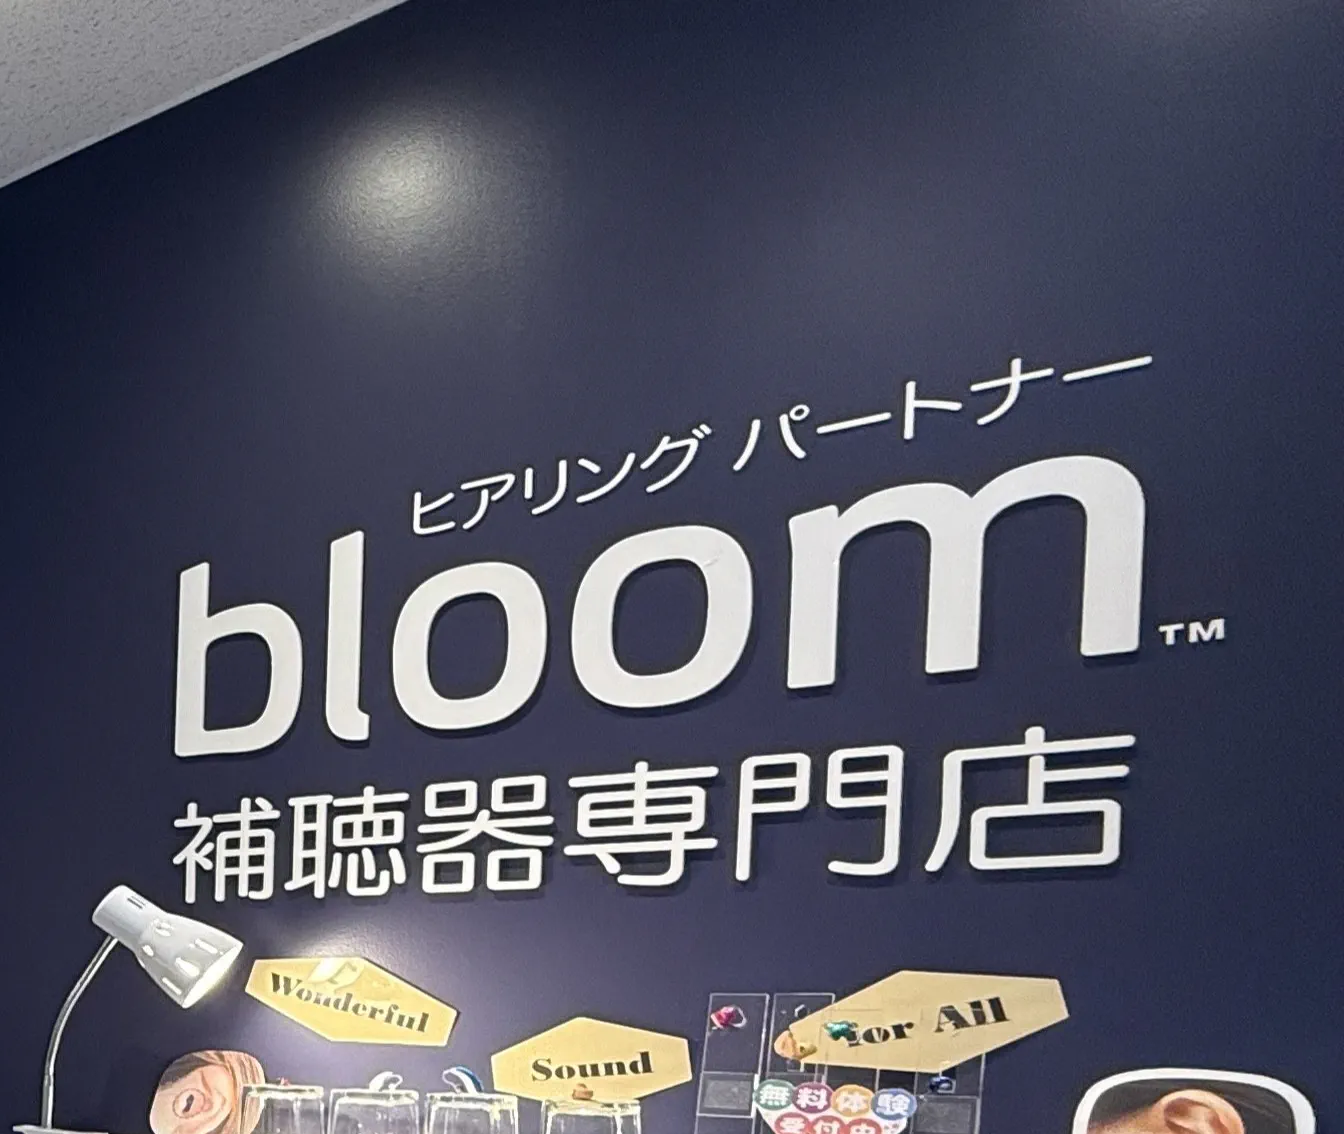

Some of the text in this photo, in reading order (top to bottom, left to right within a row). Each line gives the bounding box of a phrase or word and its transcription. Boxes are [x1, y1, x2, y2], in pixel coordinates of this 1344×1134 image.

[413, 356, 1153, 537] ヒアリング パートナー
[174, 453, 1147, 758] bloom
[170, 726, 1137, 903] 補聴器専門店
[271, 972, 429, 1032] Wonderful
[934, 996, 1010, 1033] All
[531, 1051, 653, 1082] Sound
[760, 1084, 911, 1117] 無料体験
